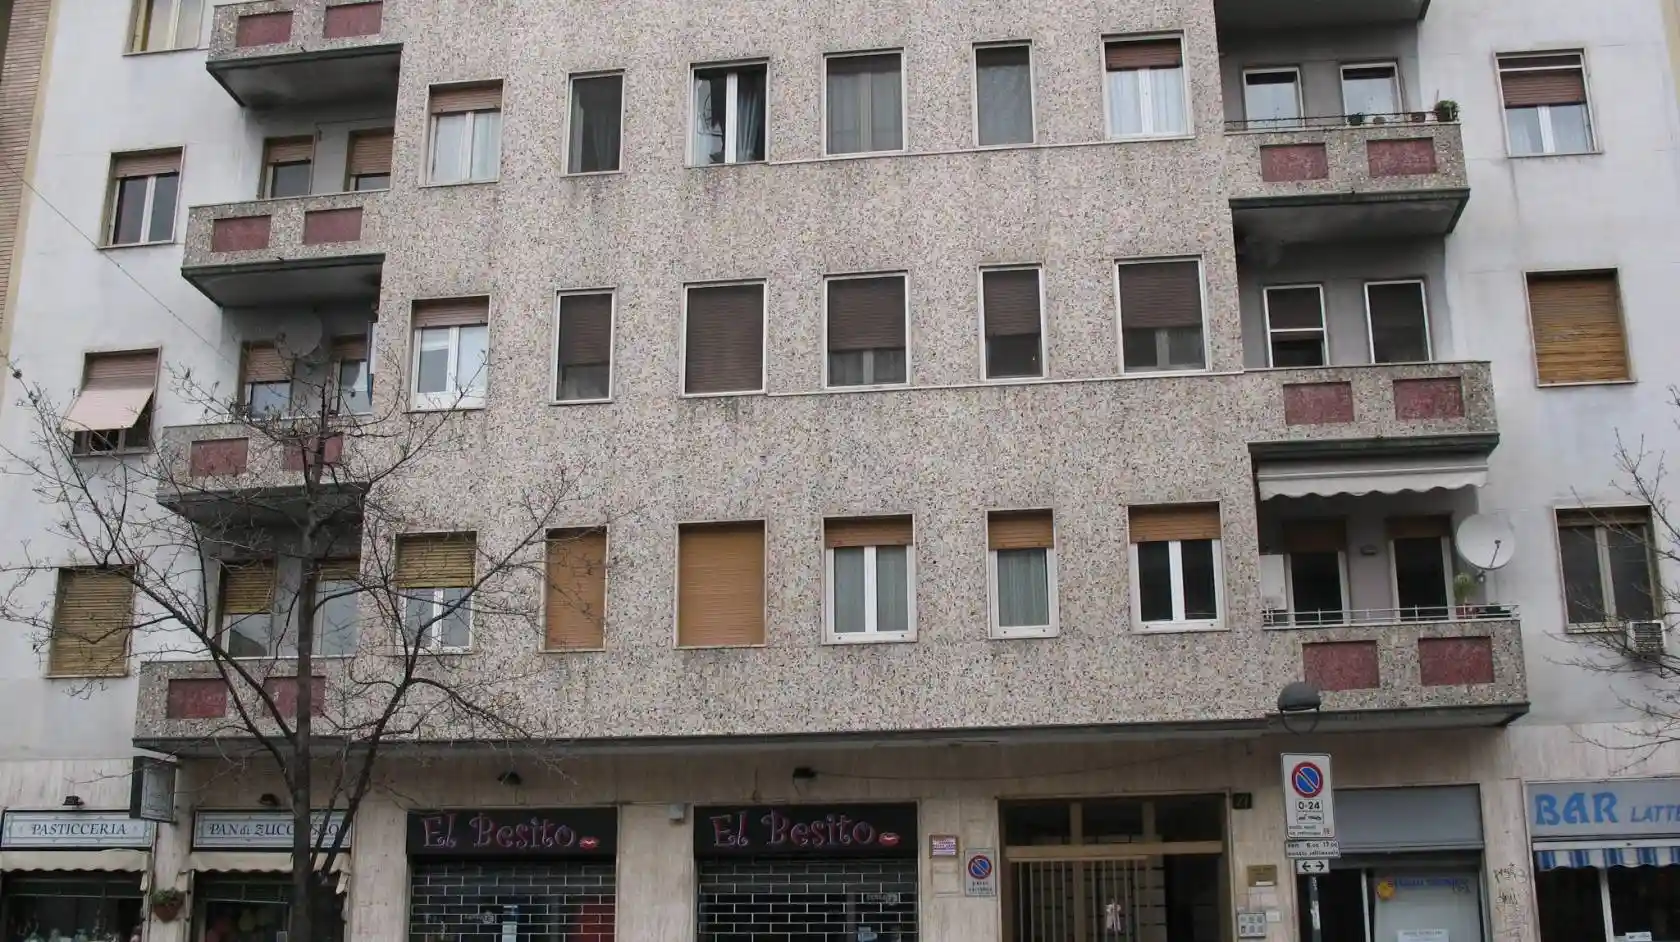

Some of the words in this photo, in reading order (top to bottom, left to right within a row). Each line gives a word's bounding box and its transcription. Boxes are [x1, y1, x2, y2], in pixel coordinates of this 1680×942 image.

[1298, 801, 1320, 810] 0-24
[1534, 791, 1618, 825] BAR
[31, 822, 127, 836] PASTICCERIA
[209, 823, 239, 836] PAN
[421, 812, 457, 848] El
[469, 812, 577, 848] Besito
[708, 810, 749, 847] El
[760, 809, 876, 847] Besito
